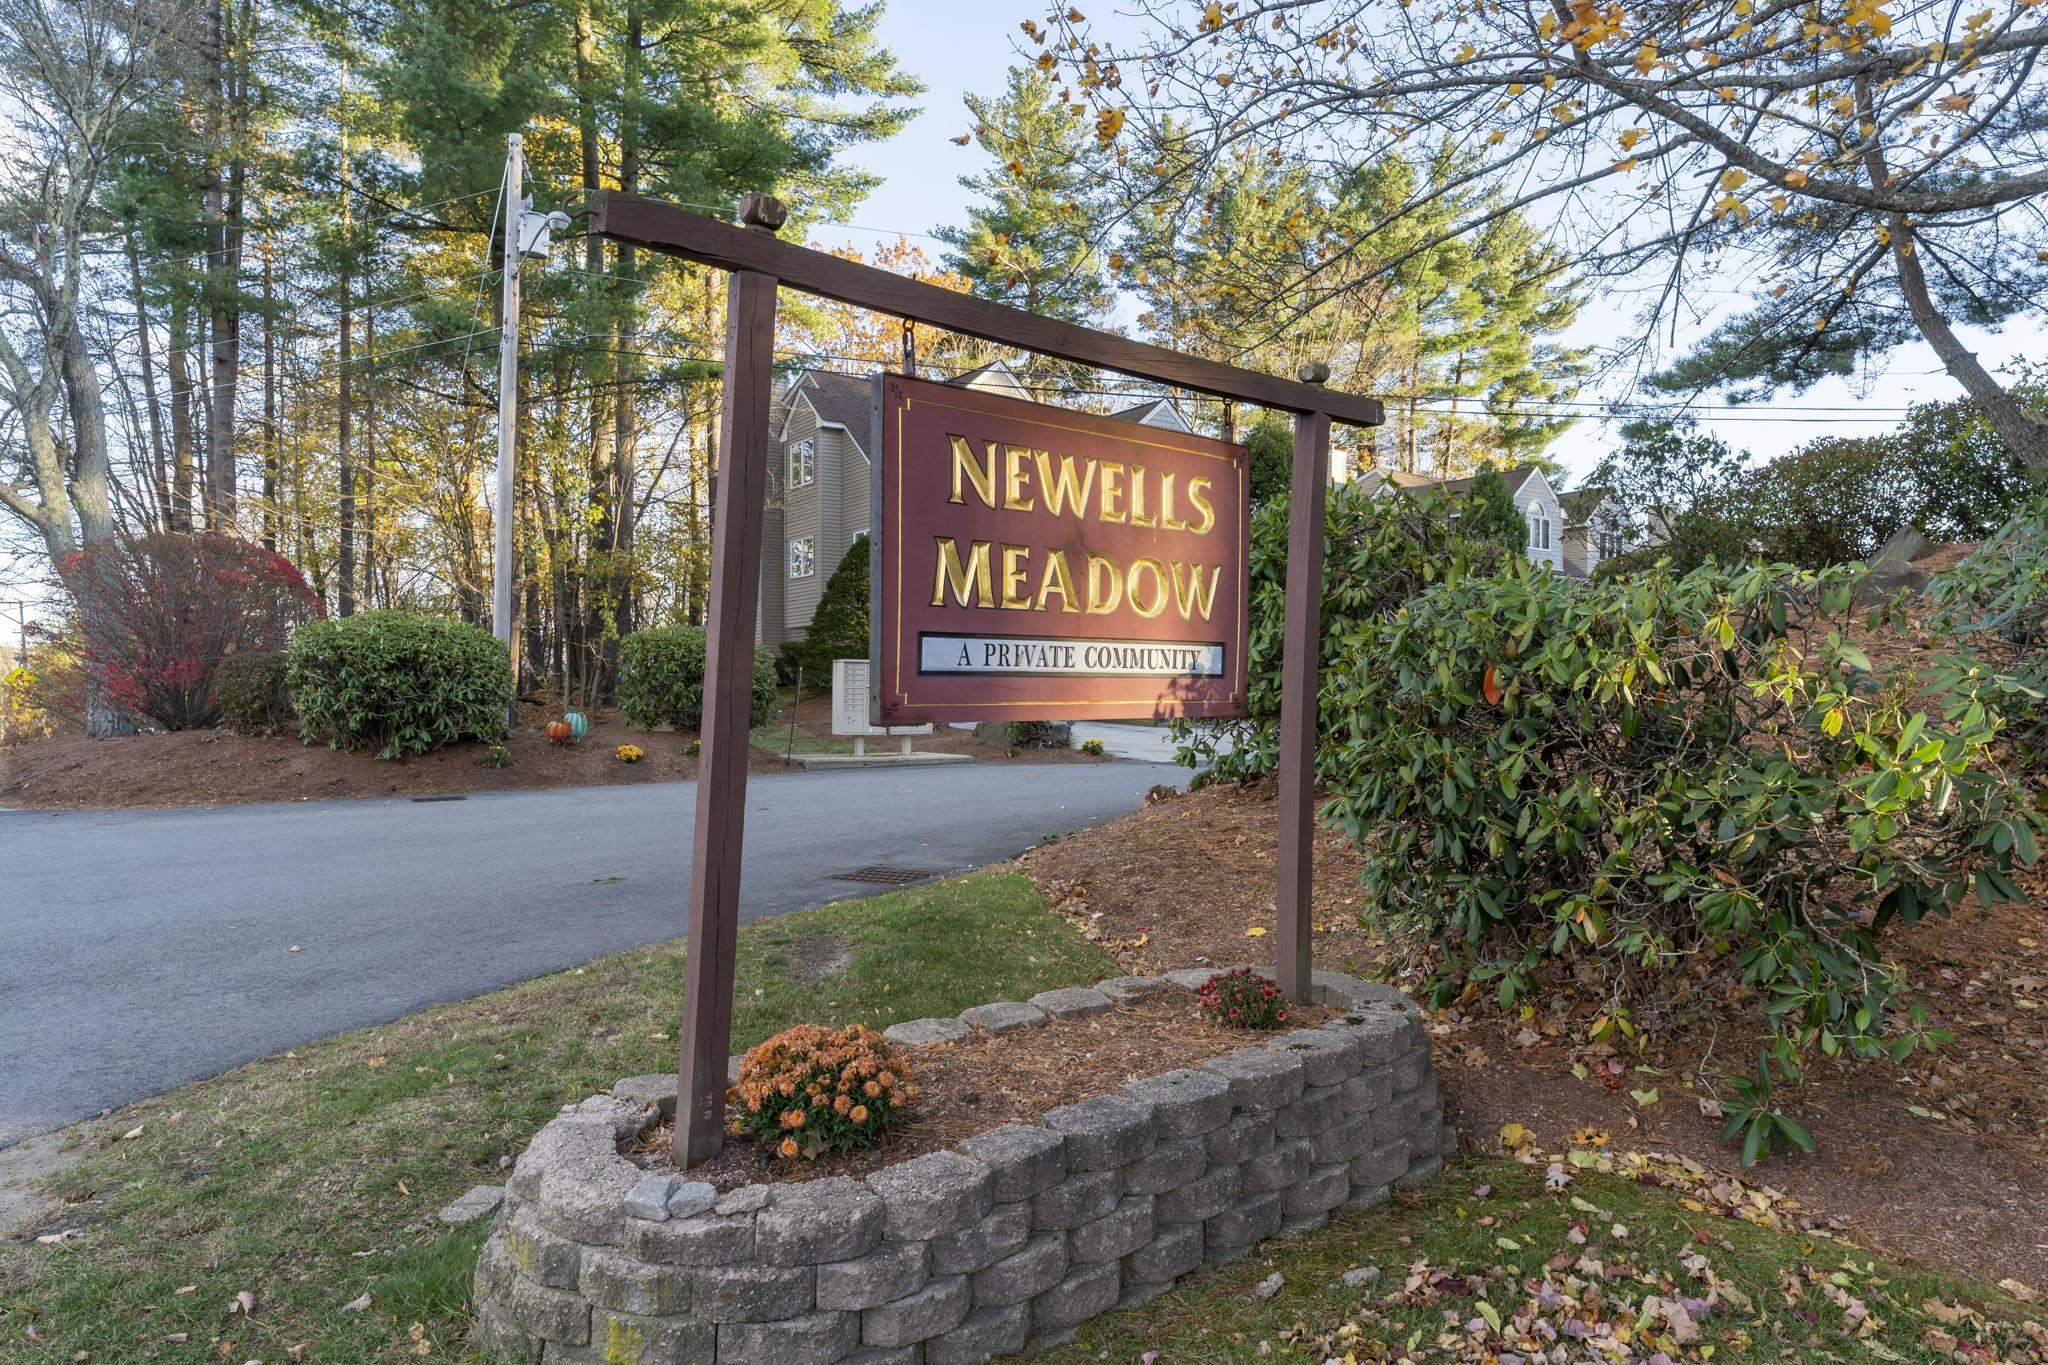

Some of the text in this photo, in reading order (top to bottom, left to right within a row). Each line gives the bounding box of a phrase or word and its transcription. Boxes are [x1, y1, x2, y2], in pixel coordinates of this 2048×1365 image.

[946, 433, 1215, 535] NEWELLS
[930, 535, 1221, 621] MEADOW
[957, 642, 1202, 671] A PRIVATE COMMUNITY
